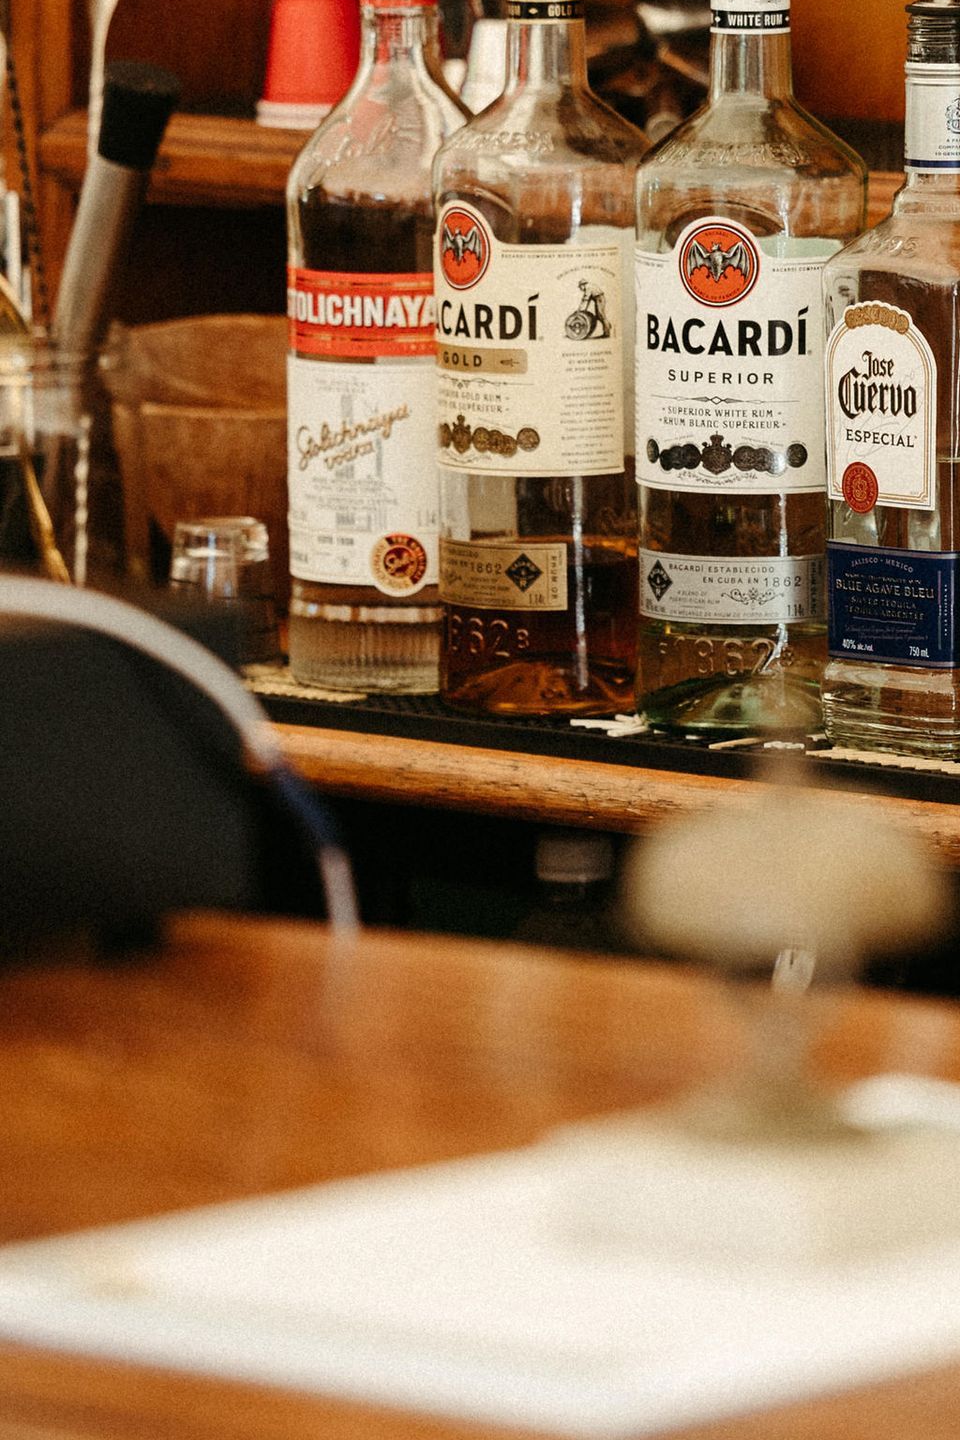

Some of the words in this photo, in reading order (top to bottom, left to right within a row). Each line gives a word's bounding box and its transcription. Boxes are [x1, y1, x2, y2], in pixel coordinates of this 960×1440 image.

[727, 13, 762, 27] WHITE
[764, 13, 783, 26] RUM
[438, 293, 540, 341] CARDÍ
[648, 306, 809, 357] BACARDÍ
[444, 351, 483, 368] GOLD
[861, 350, 894, 380] Jose
[668, 370, 774, 384] SUPERIOR
[838, 366, 917, 420] Cuervo
[668, 407, 711, 416] SUPERIOR
[663, 419, 685, 427] RHUM
[689, 420, 718, 428] BLANC
[722, 419, 779, 429] SUPÉRIEUR
[846, 428, 914, 448] ESPECIAL
[669, 563, 703, 571] BACARDÍ
[851, 557, 878, 568] JALISCO
[764, 576, 801, 587] 1862
[836, 578, 862, 592] BLUE
[866, 582, 900, 596] AGAVE
[904, 586, 934, 599] BLEU
[842, 639, 856, 651] 40%
[909, 646, 920, 657] 750
[921, 647, 929, 658] mL
